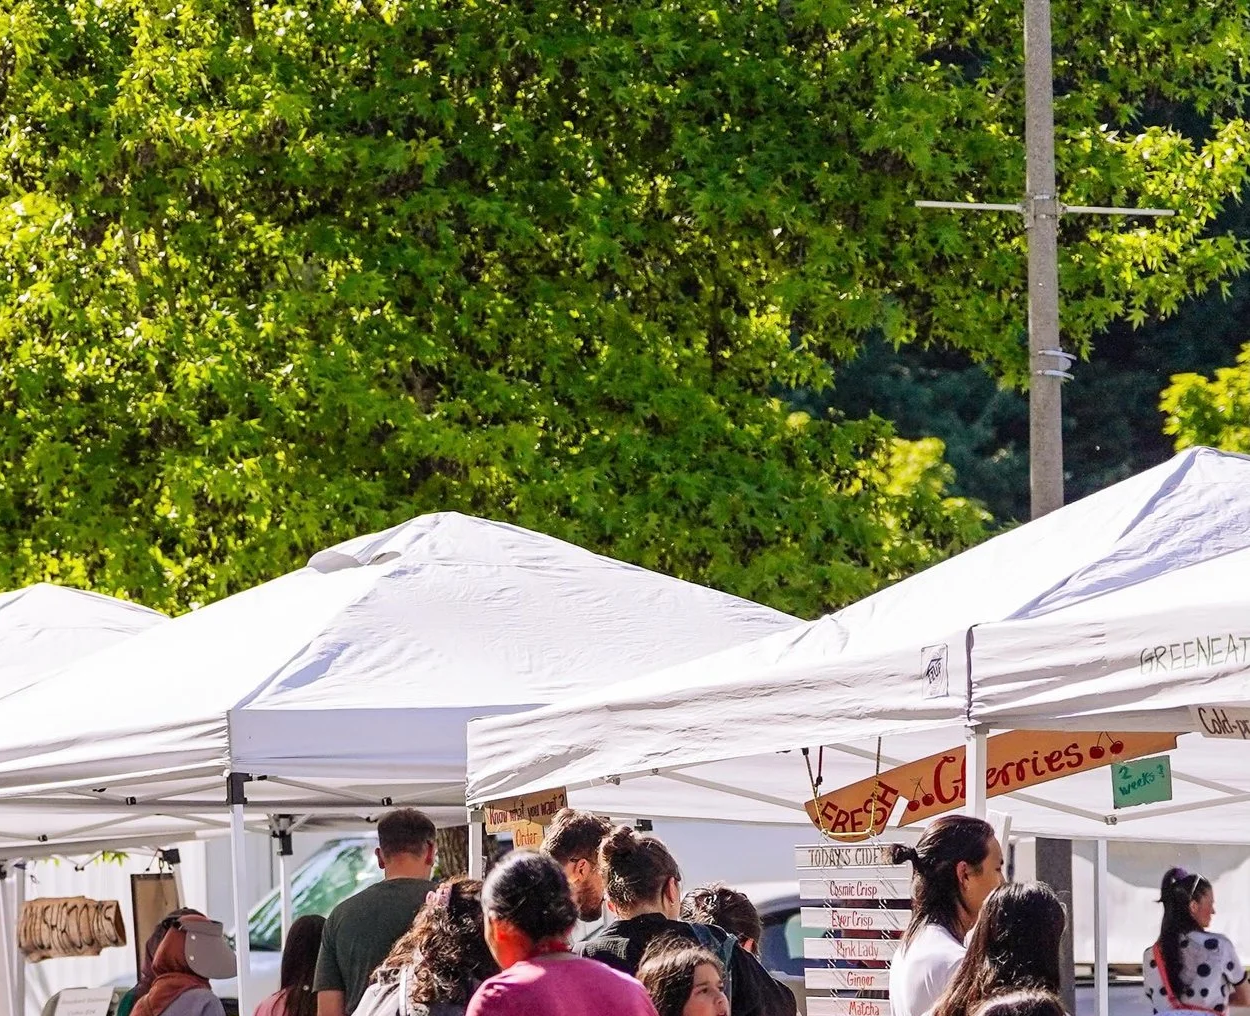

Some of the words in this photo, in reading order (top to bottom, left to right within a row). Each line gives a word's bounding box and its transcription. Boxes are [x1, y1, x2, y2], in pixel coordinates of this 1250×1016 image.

[934, 743, 1083, 804] Cerries
[490, 804, 507, 825] Know
[527, 803, 539, 825] you
[815, 781, 899, 832] FRESH
[516, 829, 538, 847] Order
[808, 848, 851, 866] TODAY'S
[855, 847, 883, 866] CIDE
[829, 880, 855, 898] Cosmic
[856, 882, 878, 898] Crisp
[831, 910, 851, 928] Ever
[851, 912, 874, 930] Crisp
[836, 940, 857, 957] Pink
[858, 943, 879, 960] Lady
[847, 971, 875, 990] Ginger
[849, 1001, 880, 1016] Matcha
